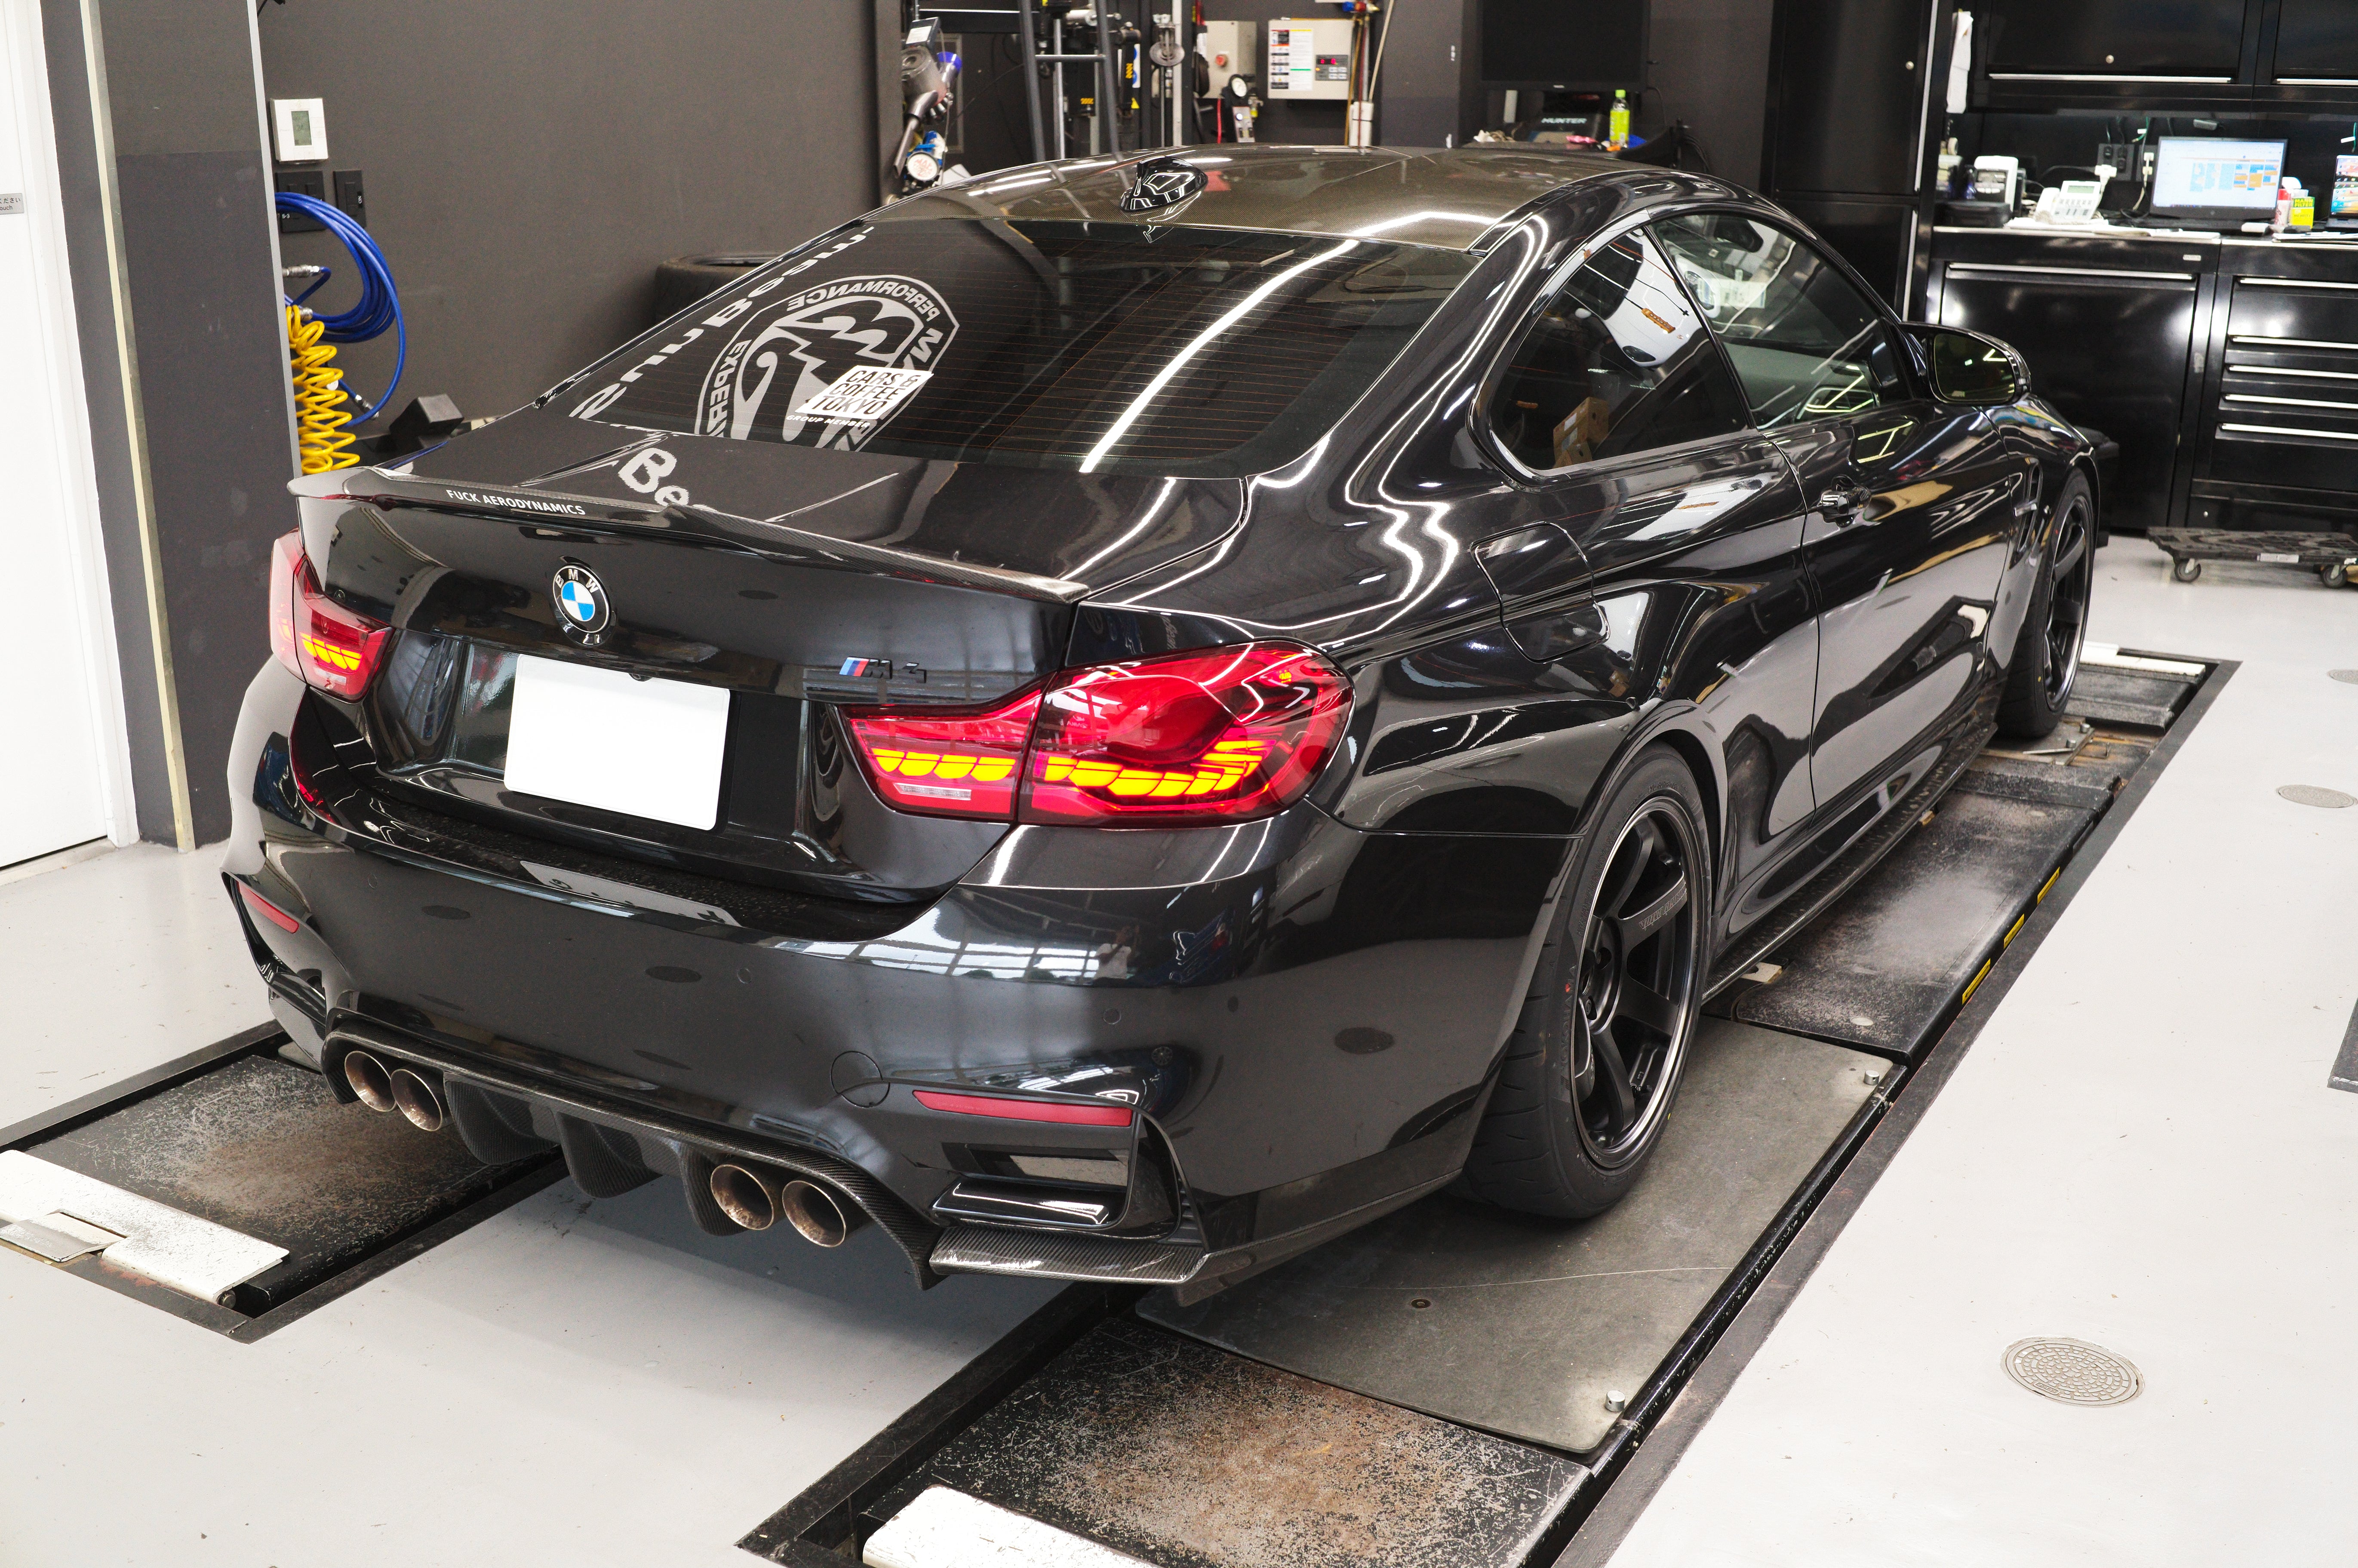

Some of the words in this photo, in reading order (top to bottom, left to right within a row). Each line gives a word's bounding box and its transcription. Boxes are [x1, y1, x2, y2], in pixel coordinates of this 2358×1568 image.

[846, 370, 900, 385] CARS
[901, 375, 921, 387] &
[829, 383, 907, 400] COFFEE
[812, 395, 888, 415] TOKYO
[786, 415, 824, 423] GROUP
[824, 418, 870, 428] MEMBER
[446, 489, 480, 504] FUCK
[482, 495, 586, 516] AERODYNAMICS
[555, 568, 599, 593] BMW
